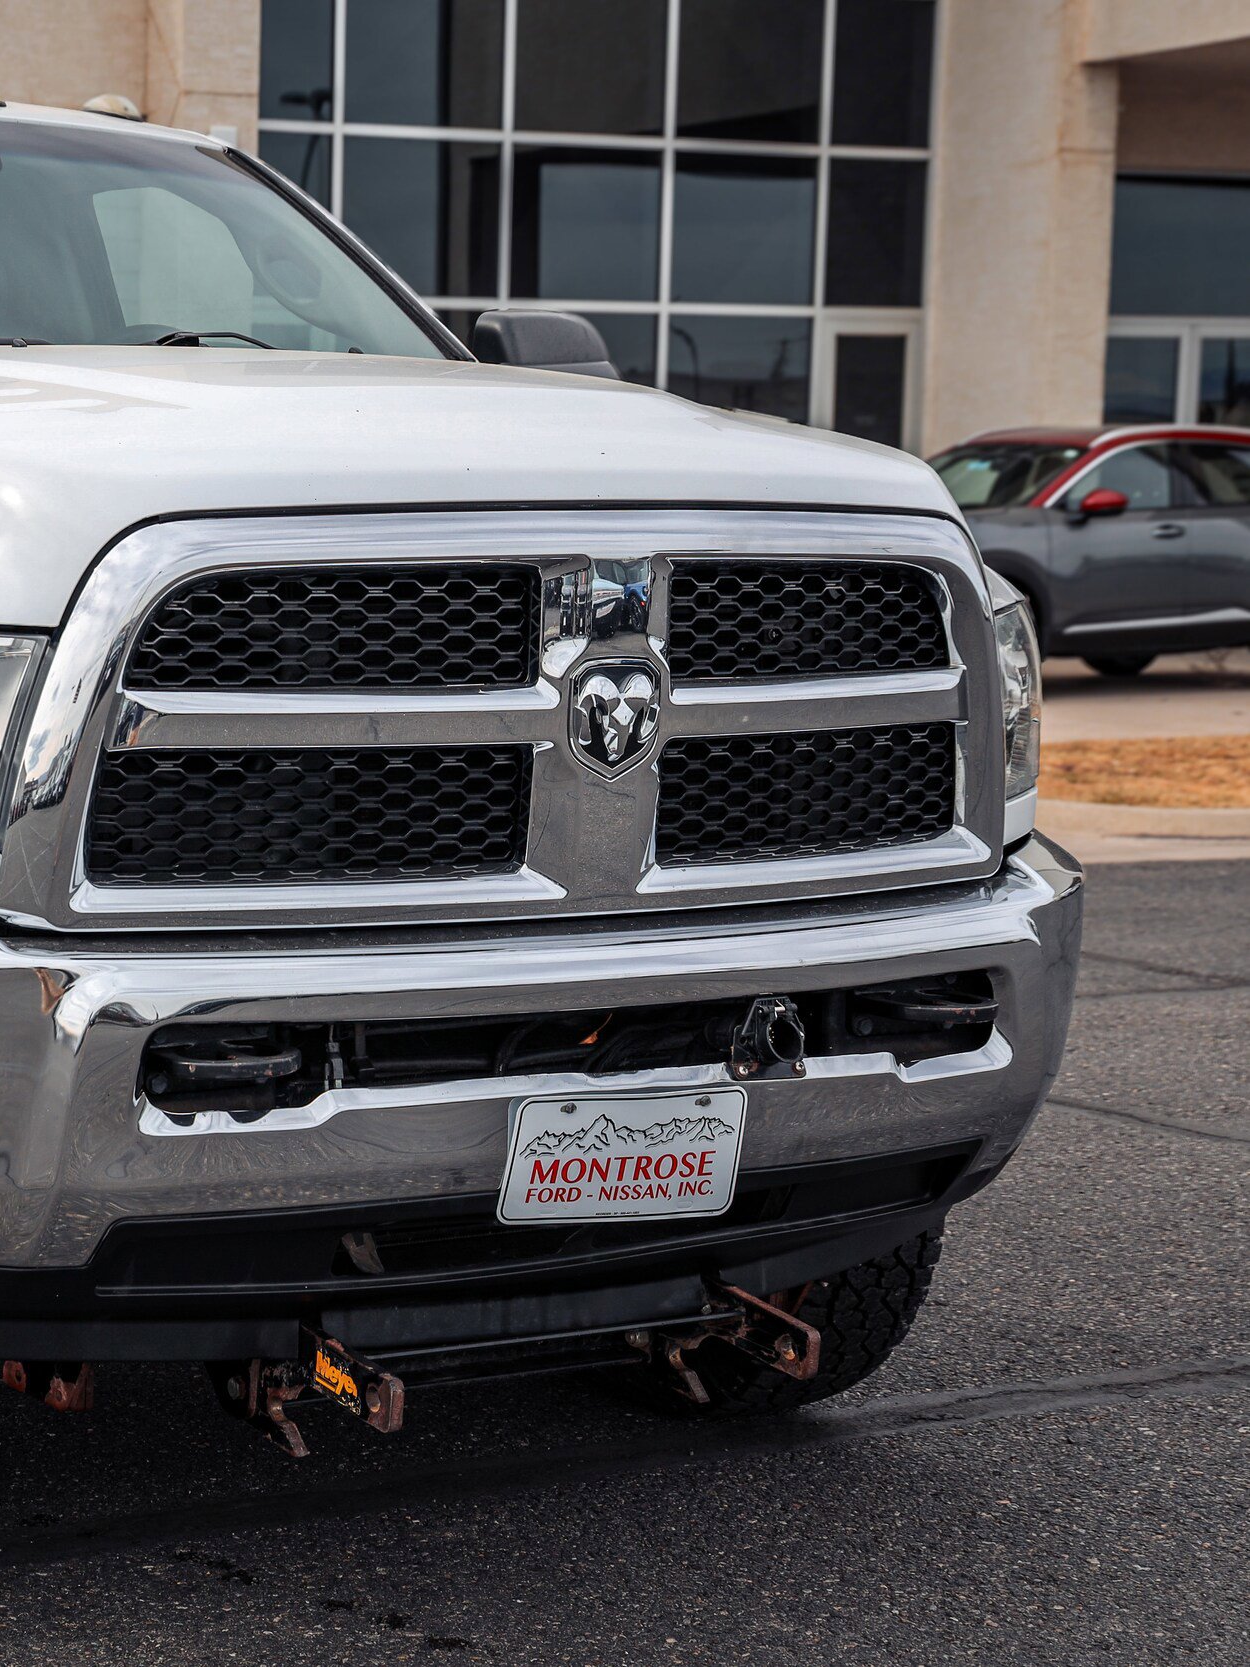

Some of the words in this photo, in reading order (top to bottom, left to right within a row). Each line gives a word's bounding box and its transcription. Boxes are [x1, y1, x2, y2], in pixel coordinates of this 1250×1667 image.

[530, 1150, 716, 1185] MONTROSE
[525, 1187, 582, 1203] FORD
[598, 1183, 672, 1202] NISSAN,
[677, 1180, 714, 1197] INC.
[316, 1350, 358, 1397] Meyer
